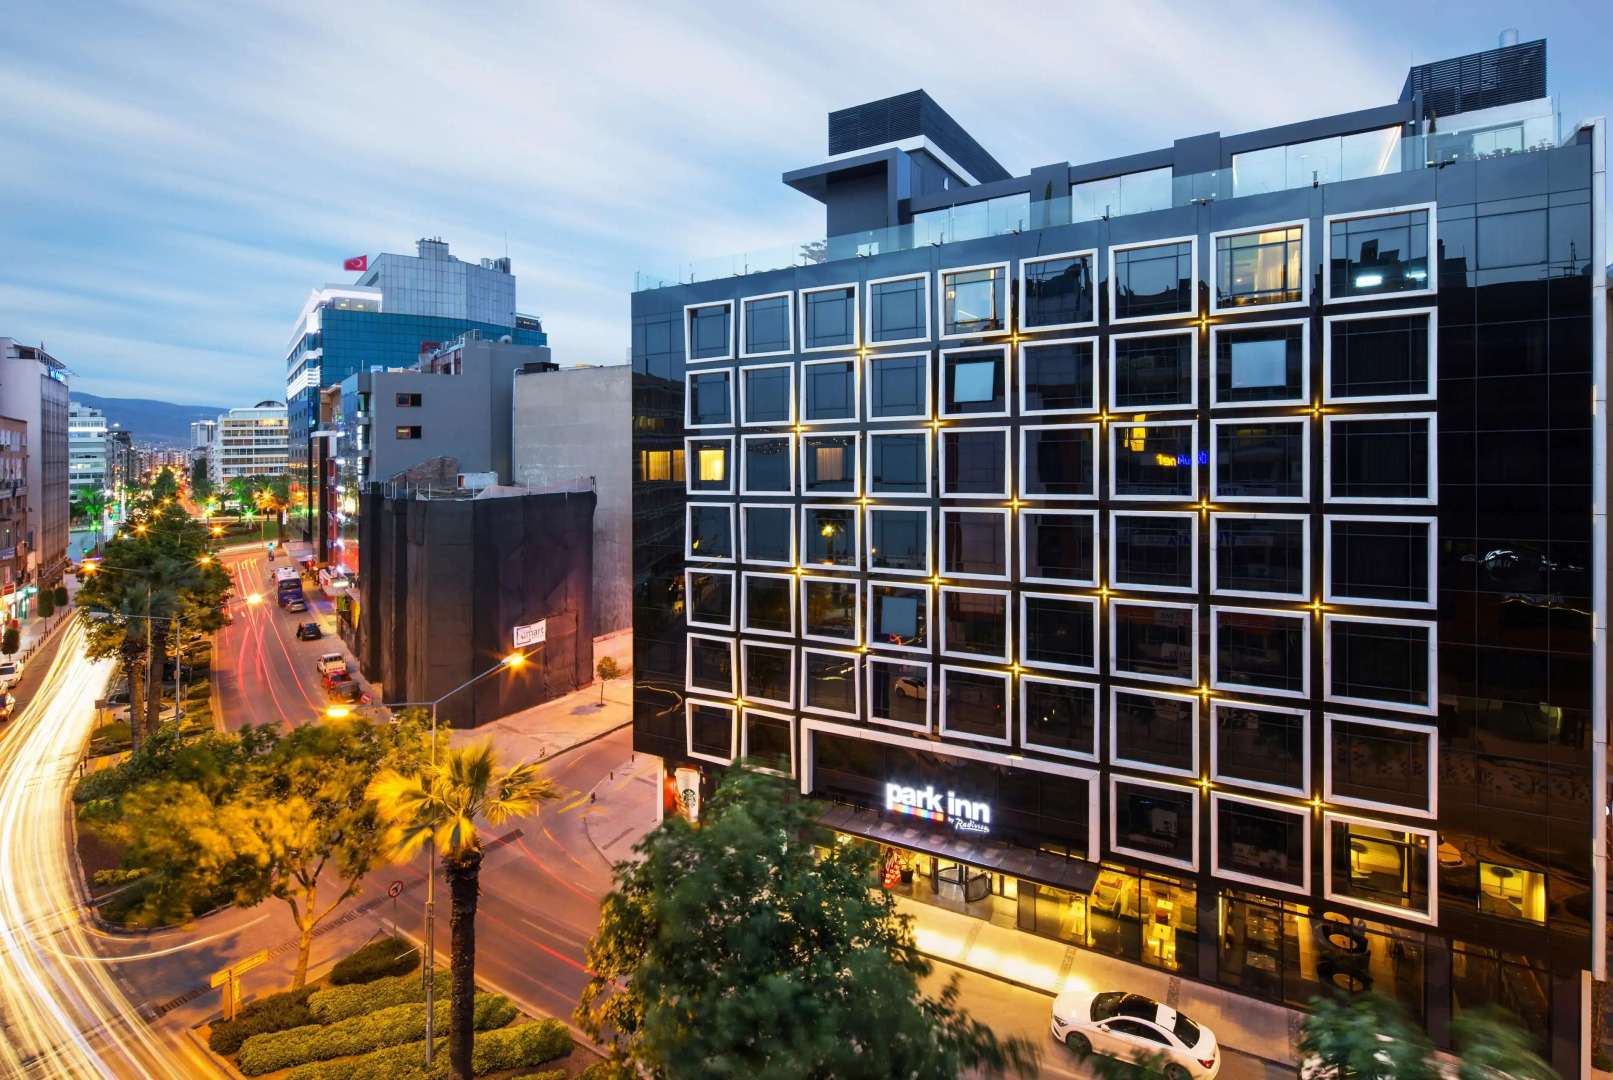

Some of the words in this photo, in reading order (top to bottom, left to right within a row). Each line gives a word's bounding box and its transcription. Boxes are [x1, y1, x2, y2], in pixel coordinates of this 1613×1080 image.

[886, 782, 944, 812] park
[947, 790, 990, 823] inn
[947, 816, 955, 824] by
[955, 817, 990, 833] Radisson
